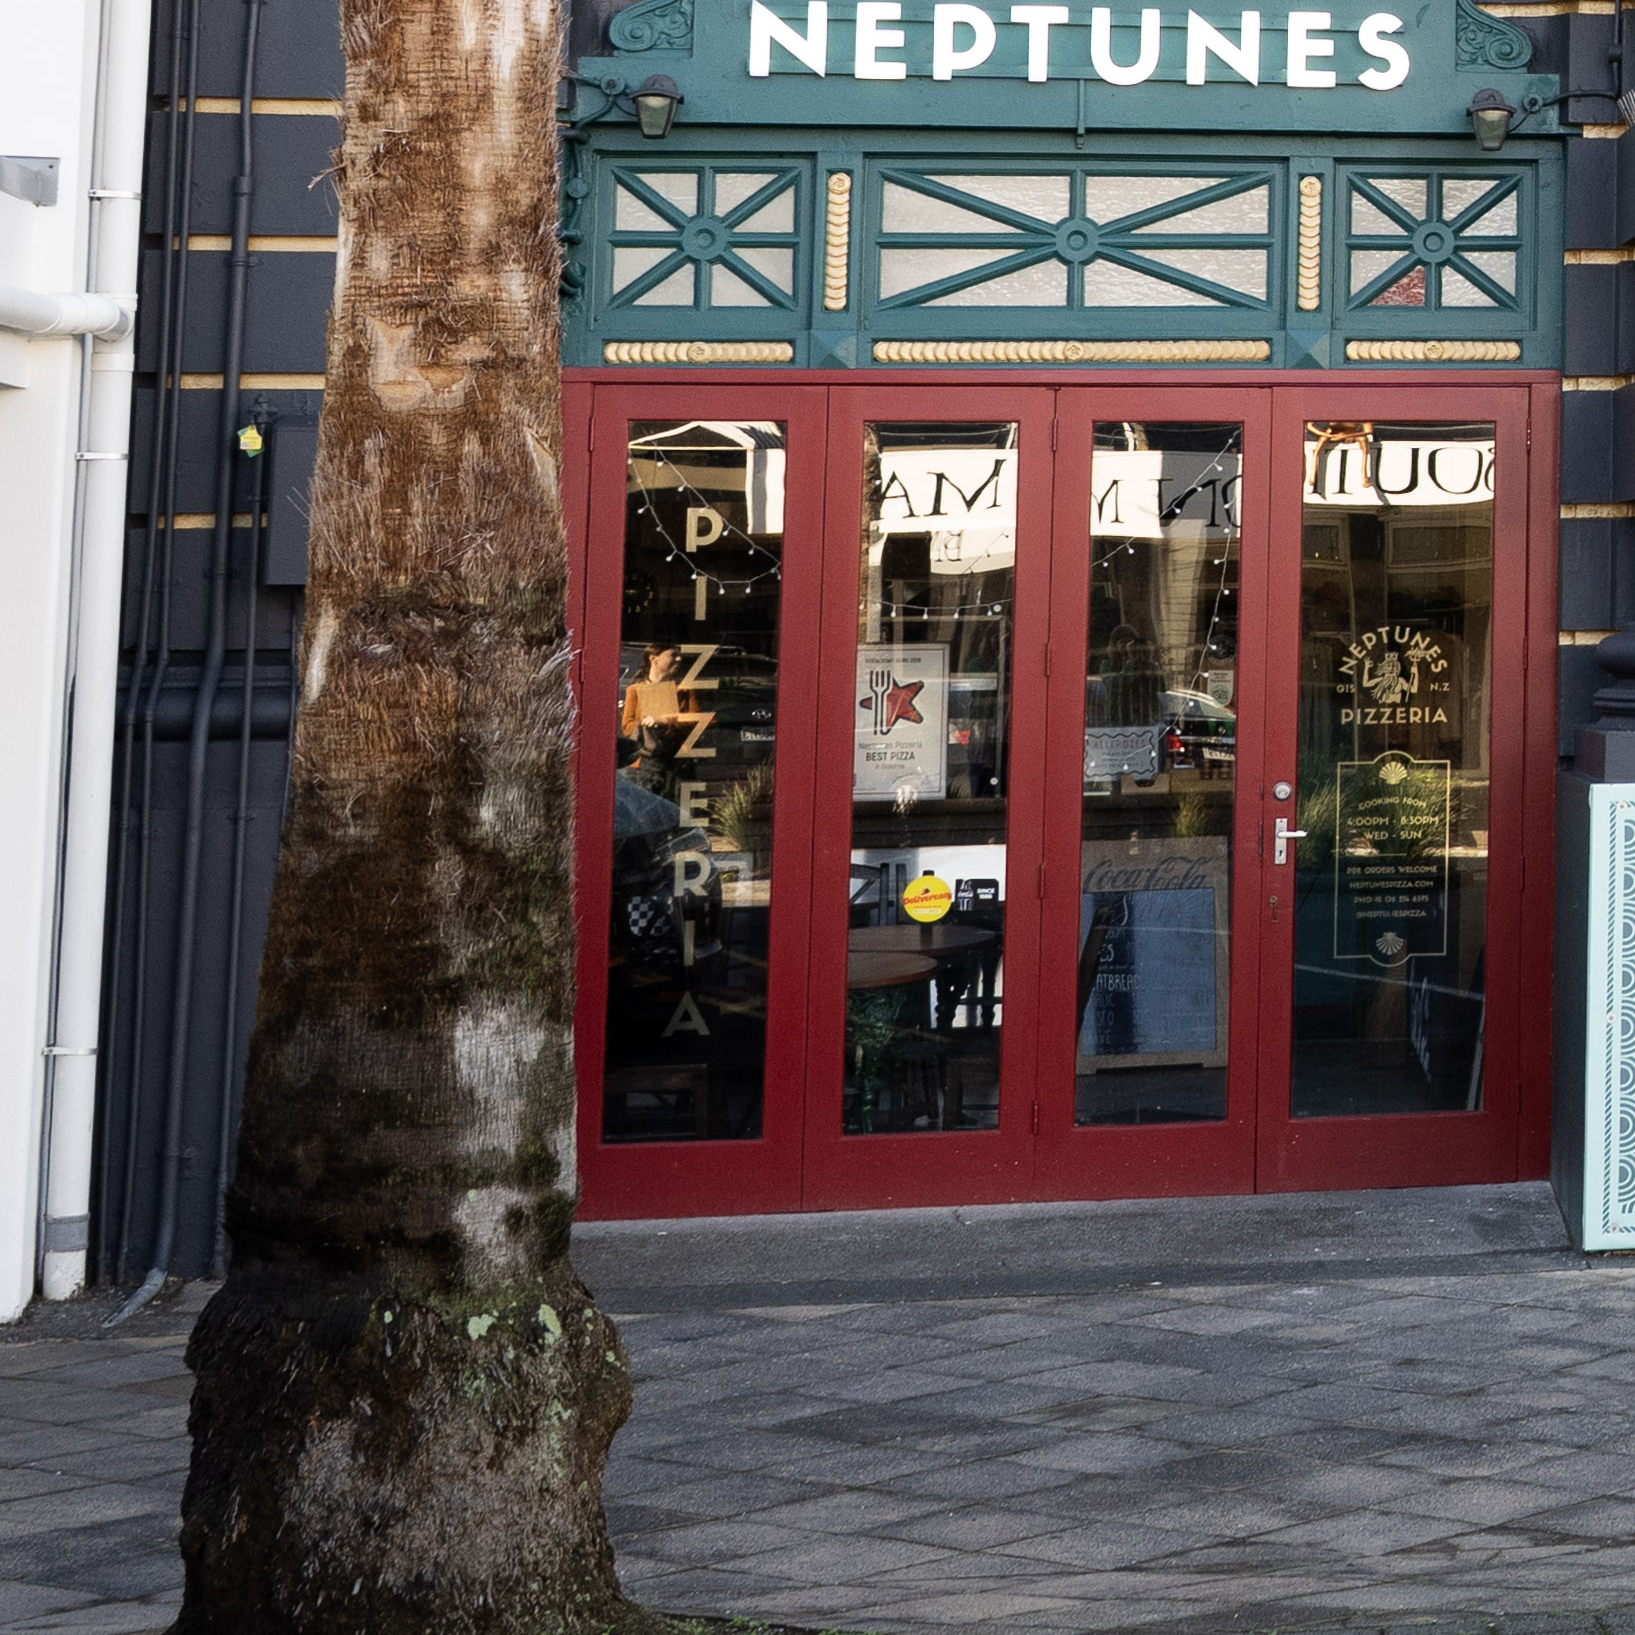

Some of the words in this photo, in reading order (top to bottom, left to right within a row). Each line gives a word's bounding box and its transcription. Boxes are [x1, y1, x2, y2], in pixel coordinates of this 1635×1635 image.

[1338, 625, 1448, 675] NEPTUNES
[1336, 684, 1356, 694] GIS
[1430, 682, 1450, 692] N.Z
[1341, 706, 1448, 725] PIZZERIA
[865, 751, 887, 762] BEST
[890, 751, 916, 761] PIZZA
[662, 506, 724, 1038] PIZZERIA
[1358, 796, 1400, 810] COOKING
[1402, 796, 1427, 809] FROM
[1346, 817, 1389, 826] 4:00PM
[1363, 831, 1389, 840] WED
[1400, 830, 1422, 839] SUN
[1398, 865, 1437, 873] WELCOME
